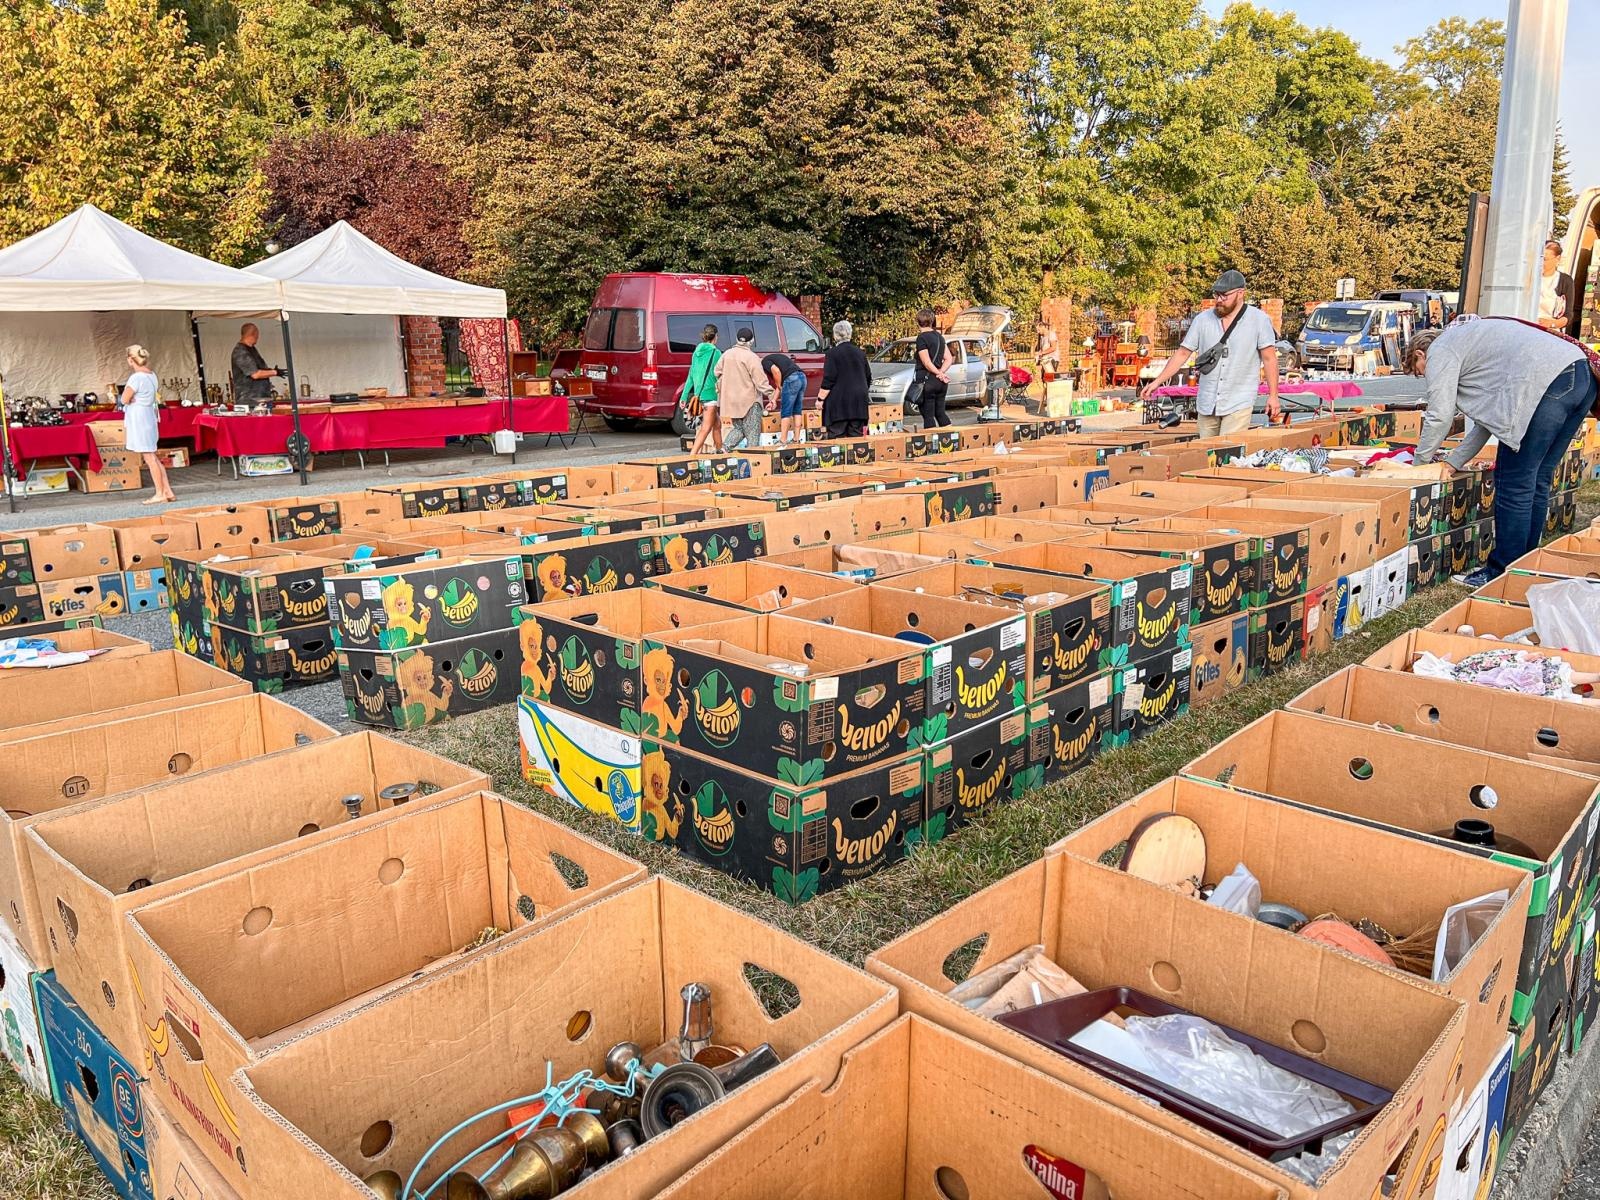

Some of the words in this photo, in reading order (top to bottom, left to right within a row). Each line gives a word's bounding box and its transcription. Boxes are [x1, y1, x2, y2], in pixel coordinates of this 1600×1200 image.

[338, 599, 371, 637] yellow
[439, 596, 478, 620] yellow
[1137, 601, 1175, 639] yellow
[1052, 628, 1096, 670] yellow
[456, 667, 497, 692] yellow
[558, 653, 593, 692] yellow
[955, 660, 1007, 708] yellow
[693, 688, 740, 734] yellow
[837, 700, 901, 751] yellow
[846, 753, 868, 762] PREMIUM
[868, 742, 890, 759] BANANAS
[1052, 715, 1096, 761] yellow
[69, 786, 74, 794] 0
[956, 757, 1006, 808] yellow
[691, 797, 734, 844] yellow
[832, 809, 897, 864] yellow
[76, 1027, 92, 1058] Bio
